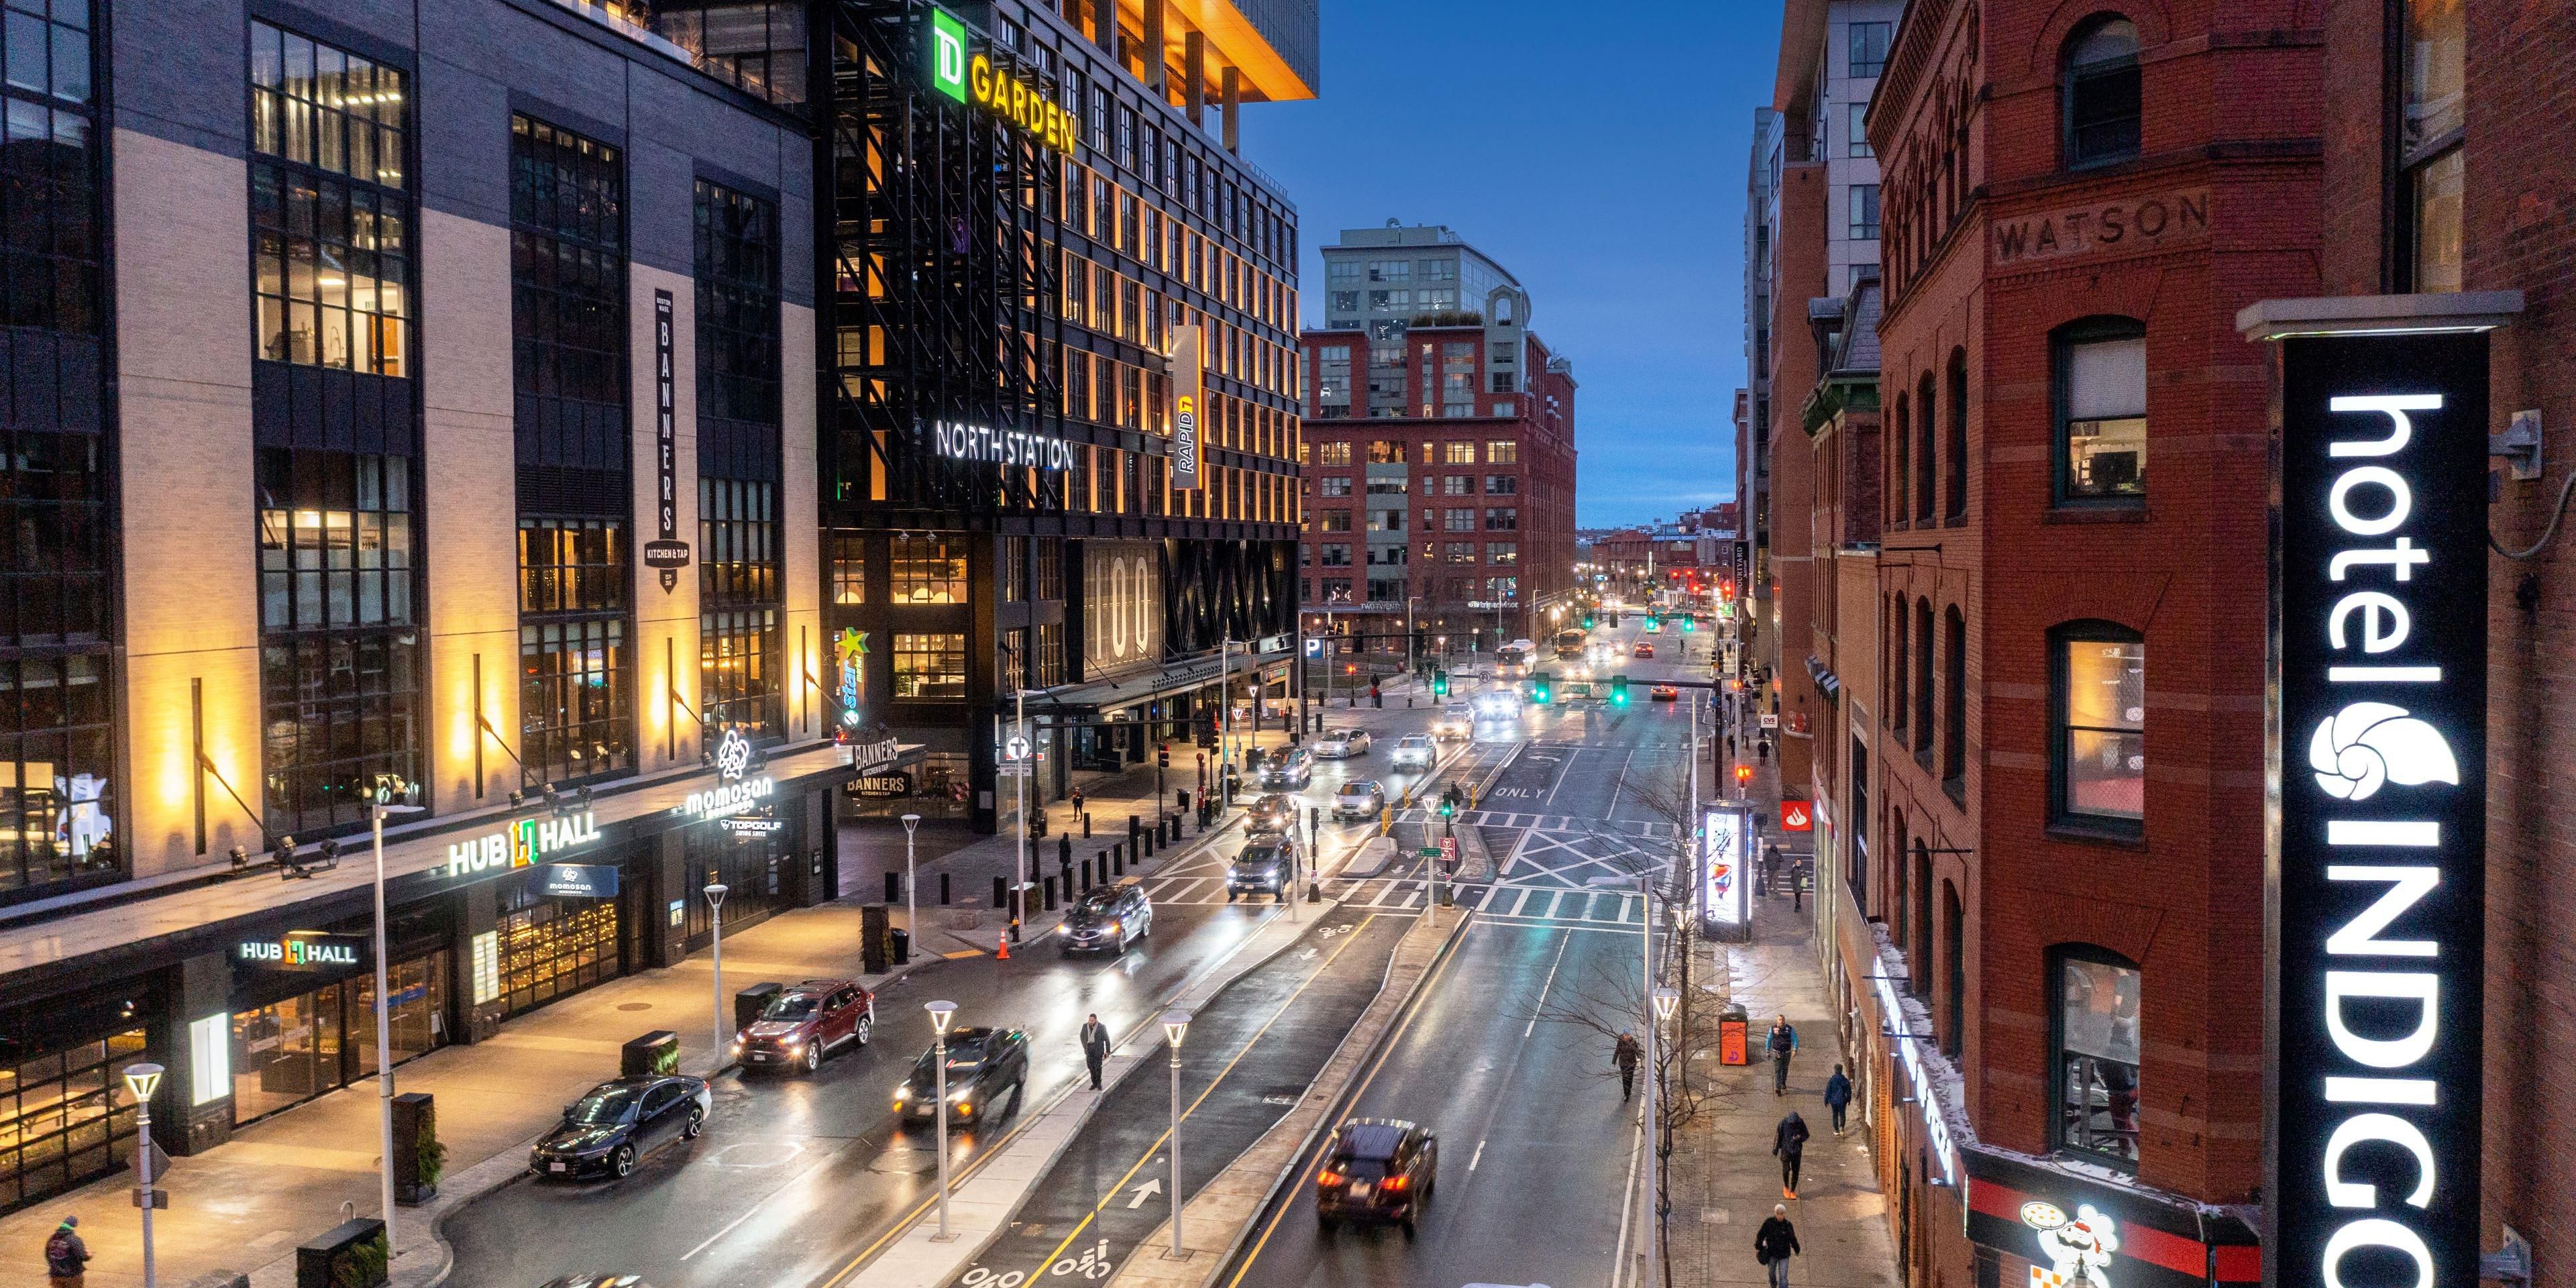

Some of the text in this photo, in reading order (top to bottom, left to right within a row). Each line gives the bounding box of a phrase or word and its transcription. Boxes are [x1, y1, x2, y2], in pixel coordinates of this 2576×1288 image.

[934, 25, 1075, 154] TD GARDEN
[1997, 193, 2209, 260] WATSON
[661, 322, 672, 531] BANNERS
[937, 420, 1073, 470] NORTH STATION
[1179, 396, 1193, 473] RAPID7
[647, 549, 672, 559] KITCHEN
[677, 549, 688, 559] TAP
[1096, 557, 1148, 659] 100
[1307, 639, 1320, 656] P
[842, 660, 857, 709] star
[855, 737, 898, 771] BANNERS
[686, 777, 772, 815] momosan
[847, 777, 904, 792] BANNERS
[1495, 788, 1546, 798] ONLY
[448, 812, 602, 877] HUB HALL
[730, 820, 782, 830] TOPGOLF
[2323, 394, 2442, 1288] hotel INDIGO
[241, 942, 358, 963] HUB HALL
